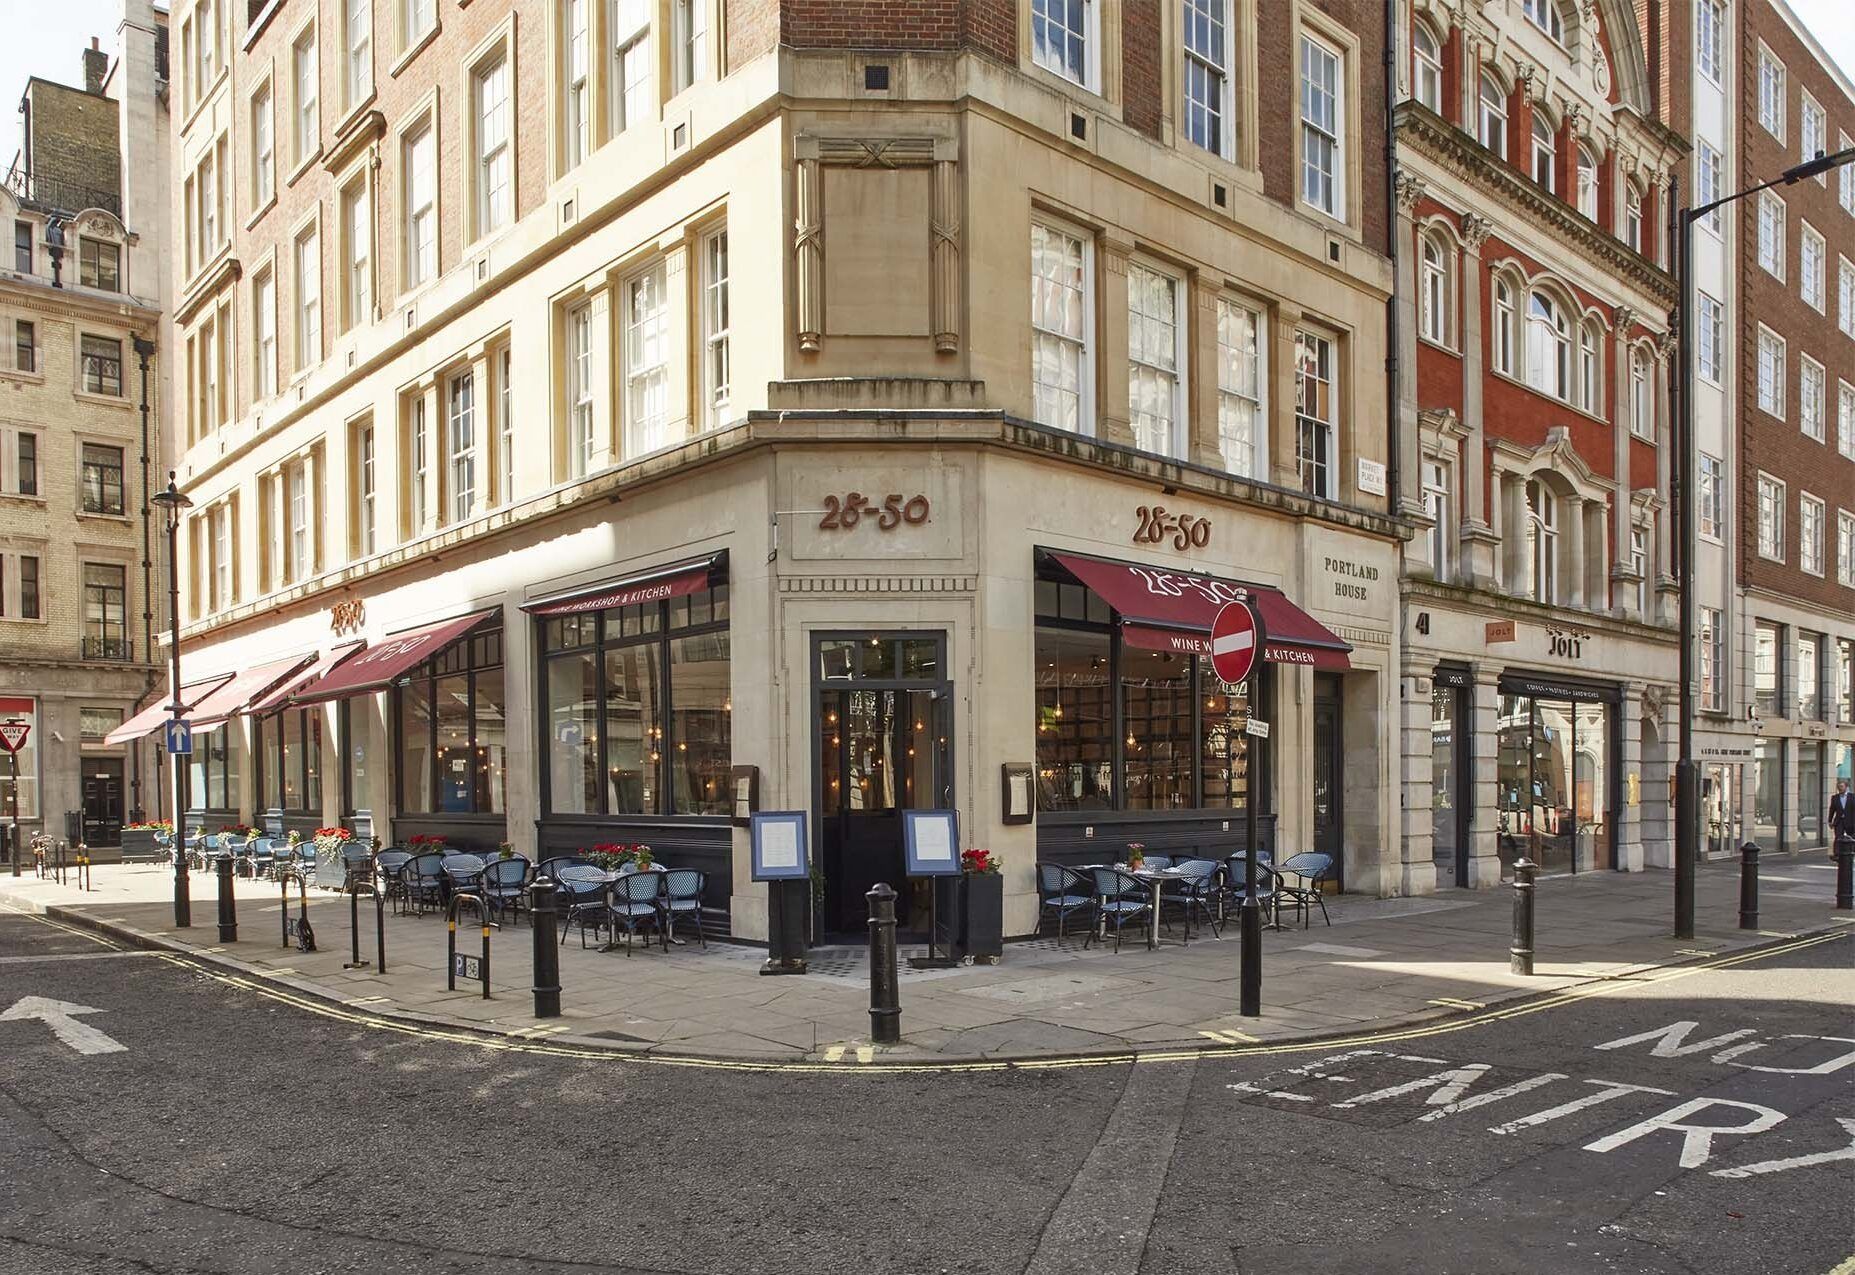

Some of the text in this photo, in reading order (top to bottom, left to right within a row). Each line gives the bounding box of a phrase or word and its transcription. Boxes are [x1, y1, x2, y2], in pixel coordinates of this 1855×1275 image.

[1361, 471, 1375, 482] PLACE
[819, 492, 930, 530] 28-50
[1133, 506, 1211, 551] 28-50
[1324, 556, 1379, 581] PORTLAND
[621, 594, 628, 604] &
[630, 584, 672, 601] KITCHEN
[1334, 582, 1367, 600] HOUSE
[1415, 612, 1430, 635] 4
[1490, 627, 1511, 636] JOLT
[1171, 636, 1200, 651] WINE
[1548, 636, 1581, 659] JOLT
[1264, 648, 1315, 663] & KITCHEN
[1593, 1021, 1855, 1074] NO
